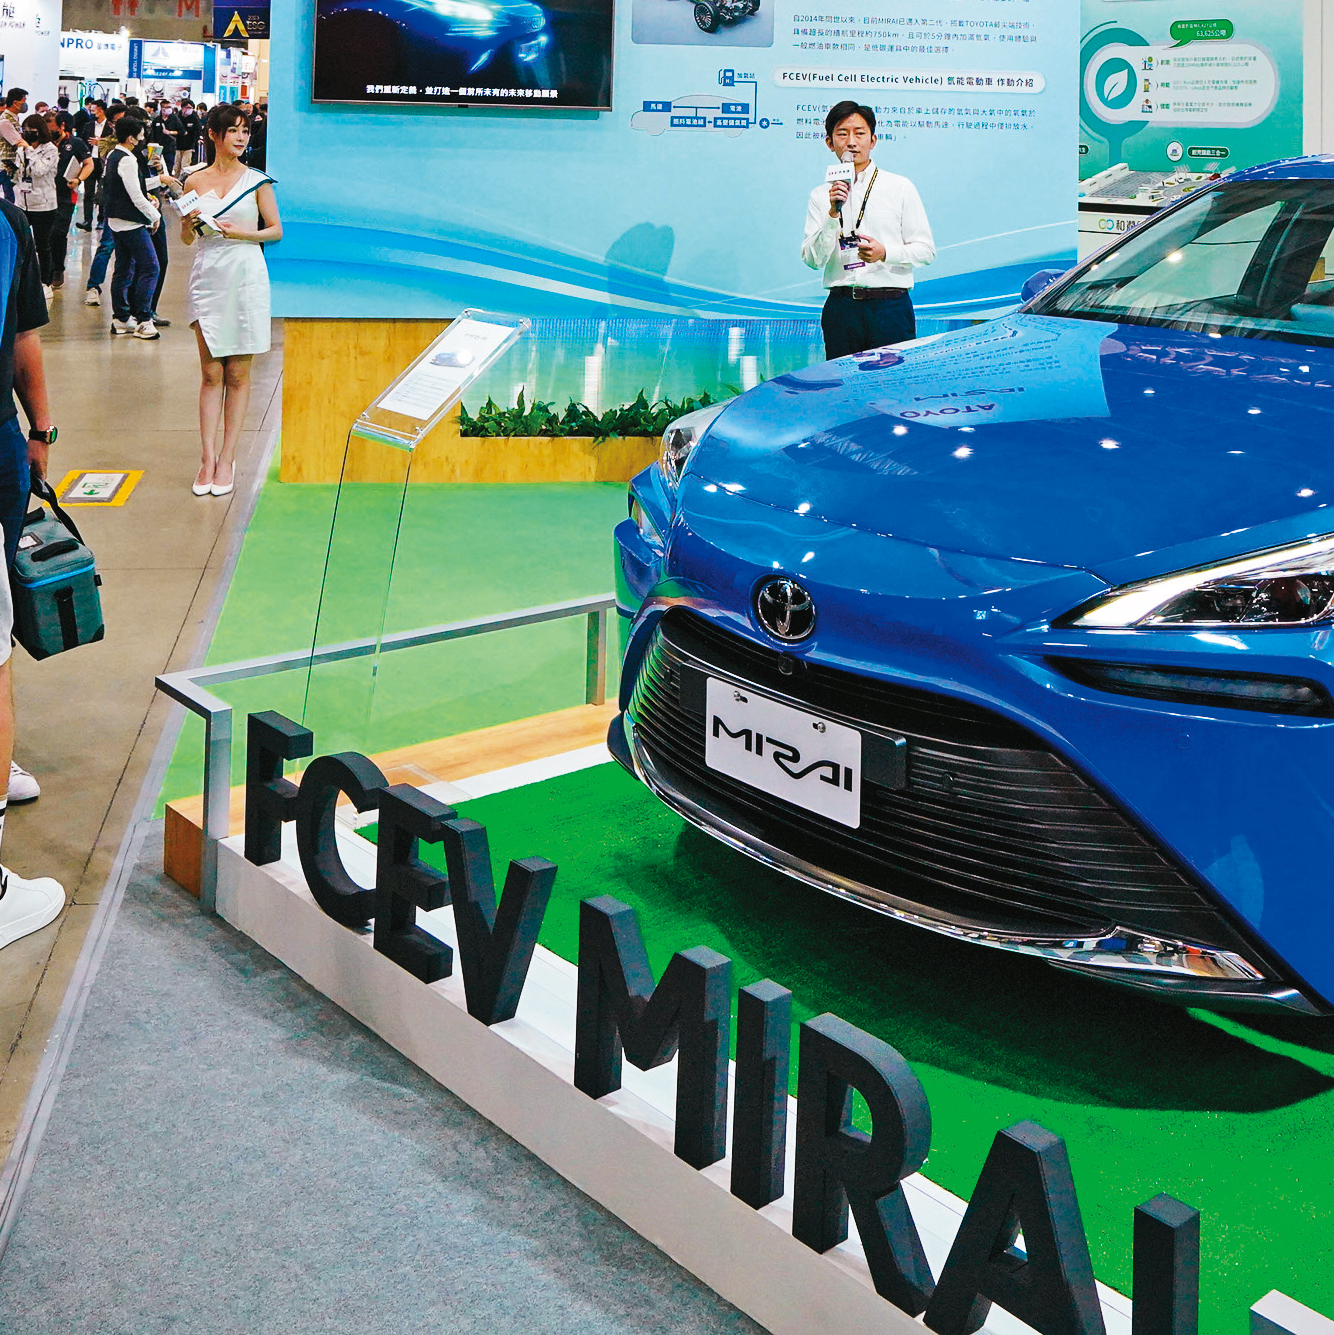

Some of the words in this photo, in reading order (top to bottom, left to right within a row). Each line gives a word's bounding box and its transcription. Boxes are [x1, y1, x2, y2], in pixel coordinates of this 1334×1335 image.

[782, 72, 835, 83] FCEV(Fuel
[837, 73, 858, 83] Cell
[860, 74, 899, 85] Electric
[903, 76, 944, 86] Vehicle)
[997, 78, 1035, 89] 作動介紹
[712, 714, 853, 793] MIRAI
[243, 709, 558, 1027] FCEV
[573, 894, 1200, 1335] MIRAI
